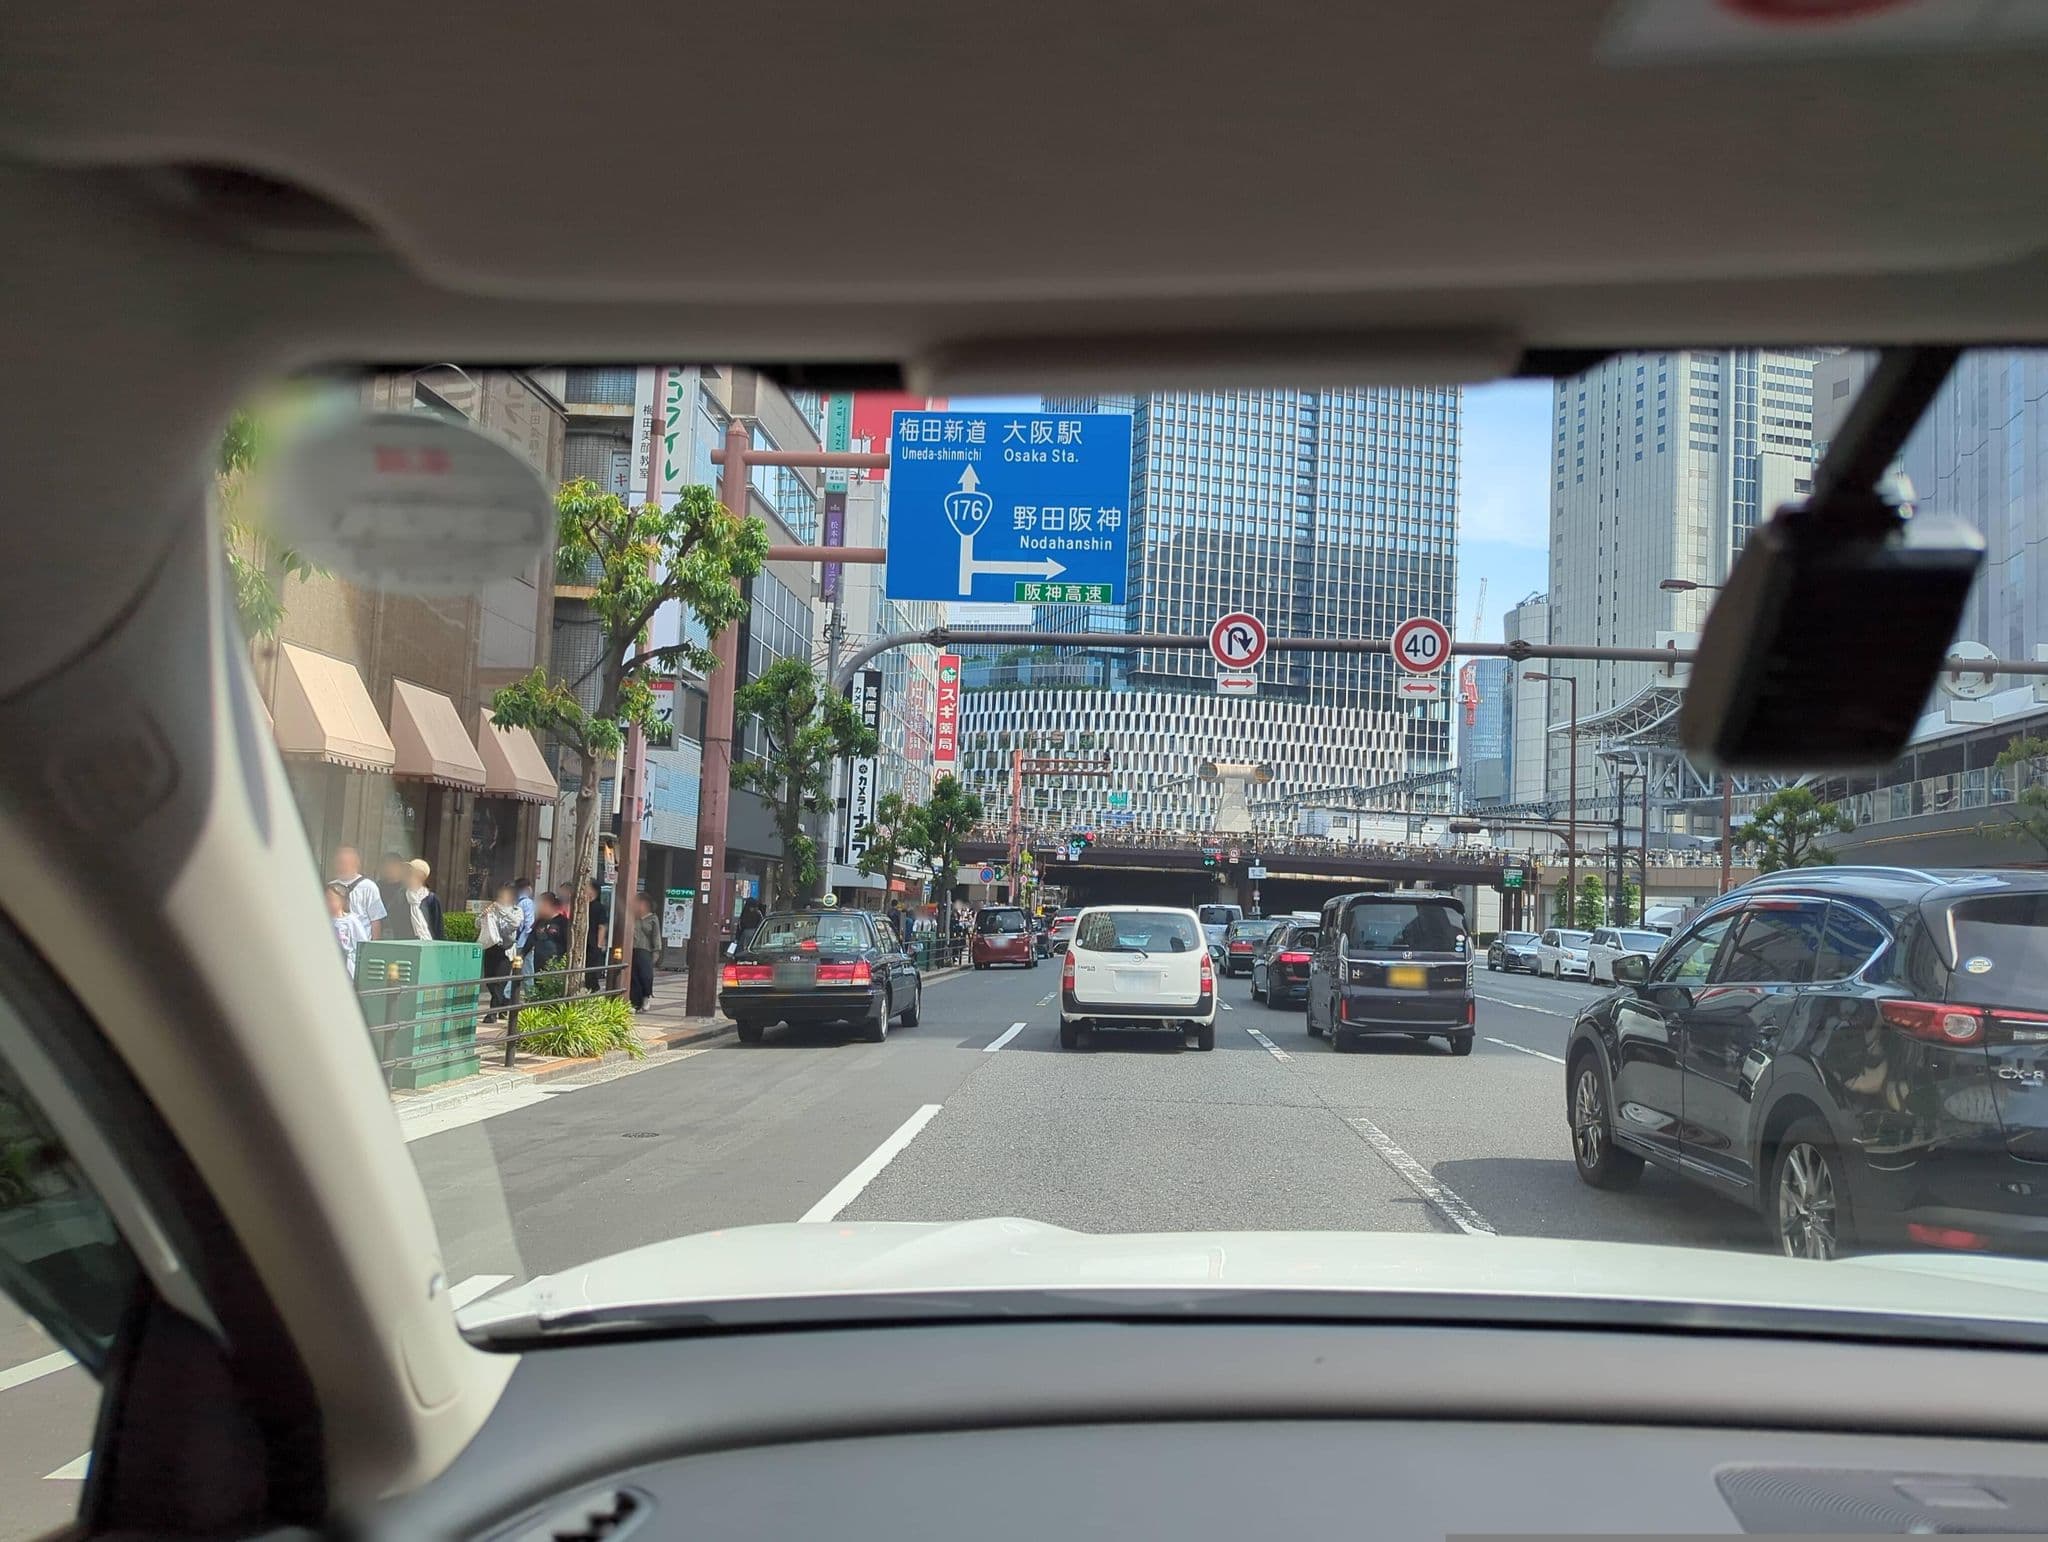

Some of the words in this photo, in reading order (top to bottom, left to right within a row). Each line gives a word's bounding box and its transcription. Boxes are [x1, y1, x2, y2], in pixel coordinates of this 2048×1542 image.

[899, 418, 987, 444] 梅田新道
[1002, 420, 1082, 444] 大阪駅
[902, 447, 982, 461] Umeda-shinmichi
[1004, 449, 1046, 463] Osaka
[1052, 450, 1079, 463] Sta.
[952, 500, 984, 521] 176
[1013, 506, 1121, 532] 野田阪神
[1020, 536, 1112, 551] Nodahanshin
[1024, 584, 1102, 603] 阪神高速
[1405, 633, 1436, 658] 40
[938, 688, 957, 751] スギ薬局
[1998, 1068, 2044, 1079] CX-8
